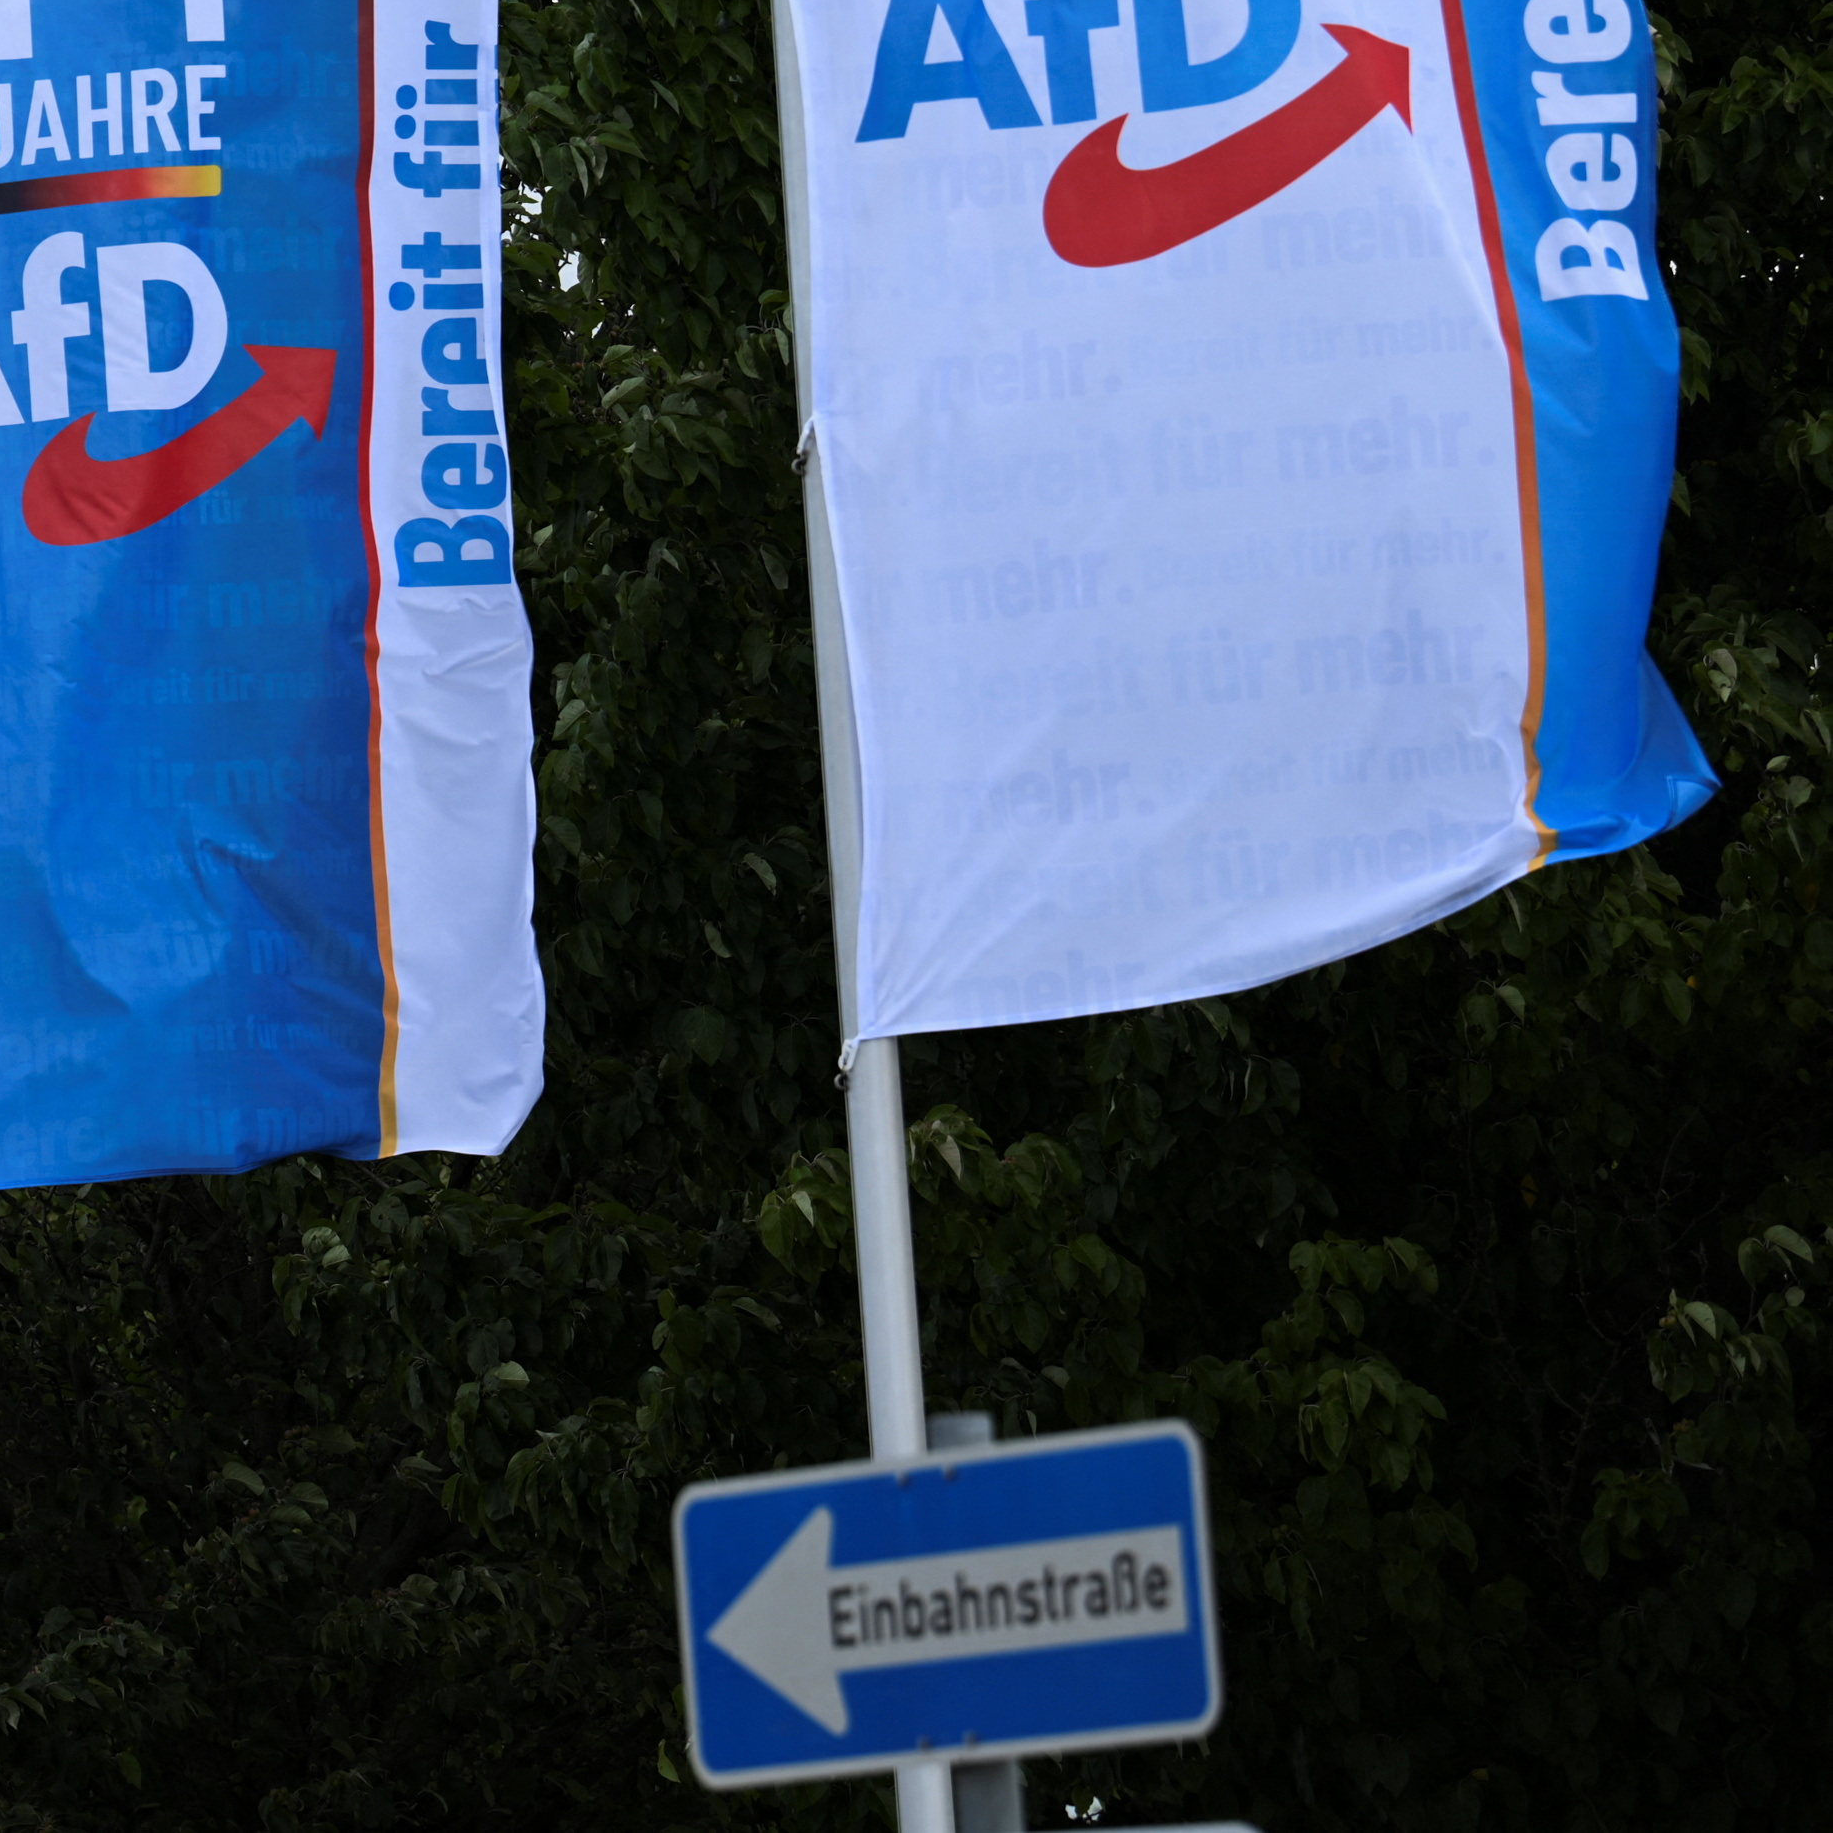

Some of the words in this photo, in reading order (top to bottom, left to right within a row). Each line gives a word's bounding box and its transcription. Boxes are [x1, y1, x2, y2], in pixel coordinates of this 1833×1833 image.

[394, 22, 483, 203] für
[388, 231, 511, 588] Bereit
[828, 1551, 1171, 1651] Einbahnstraße
